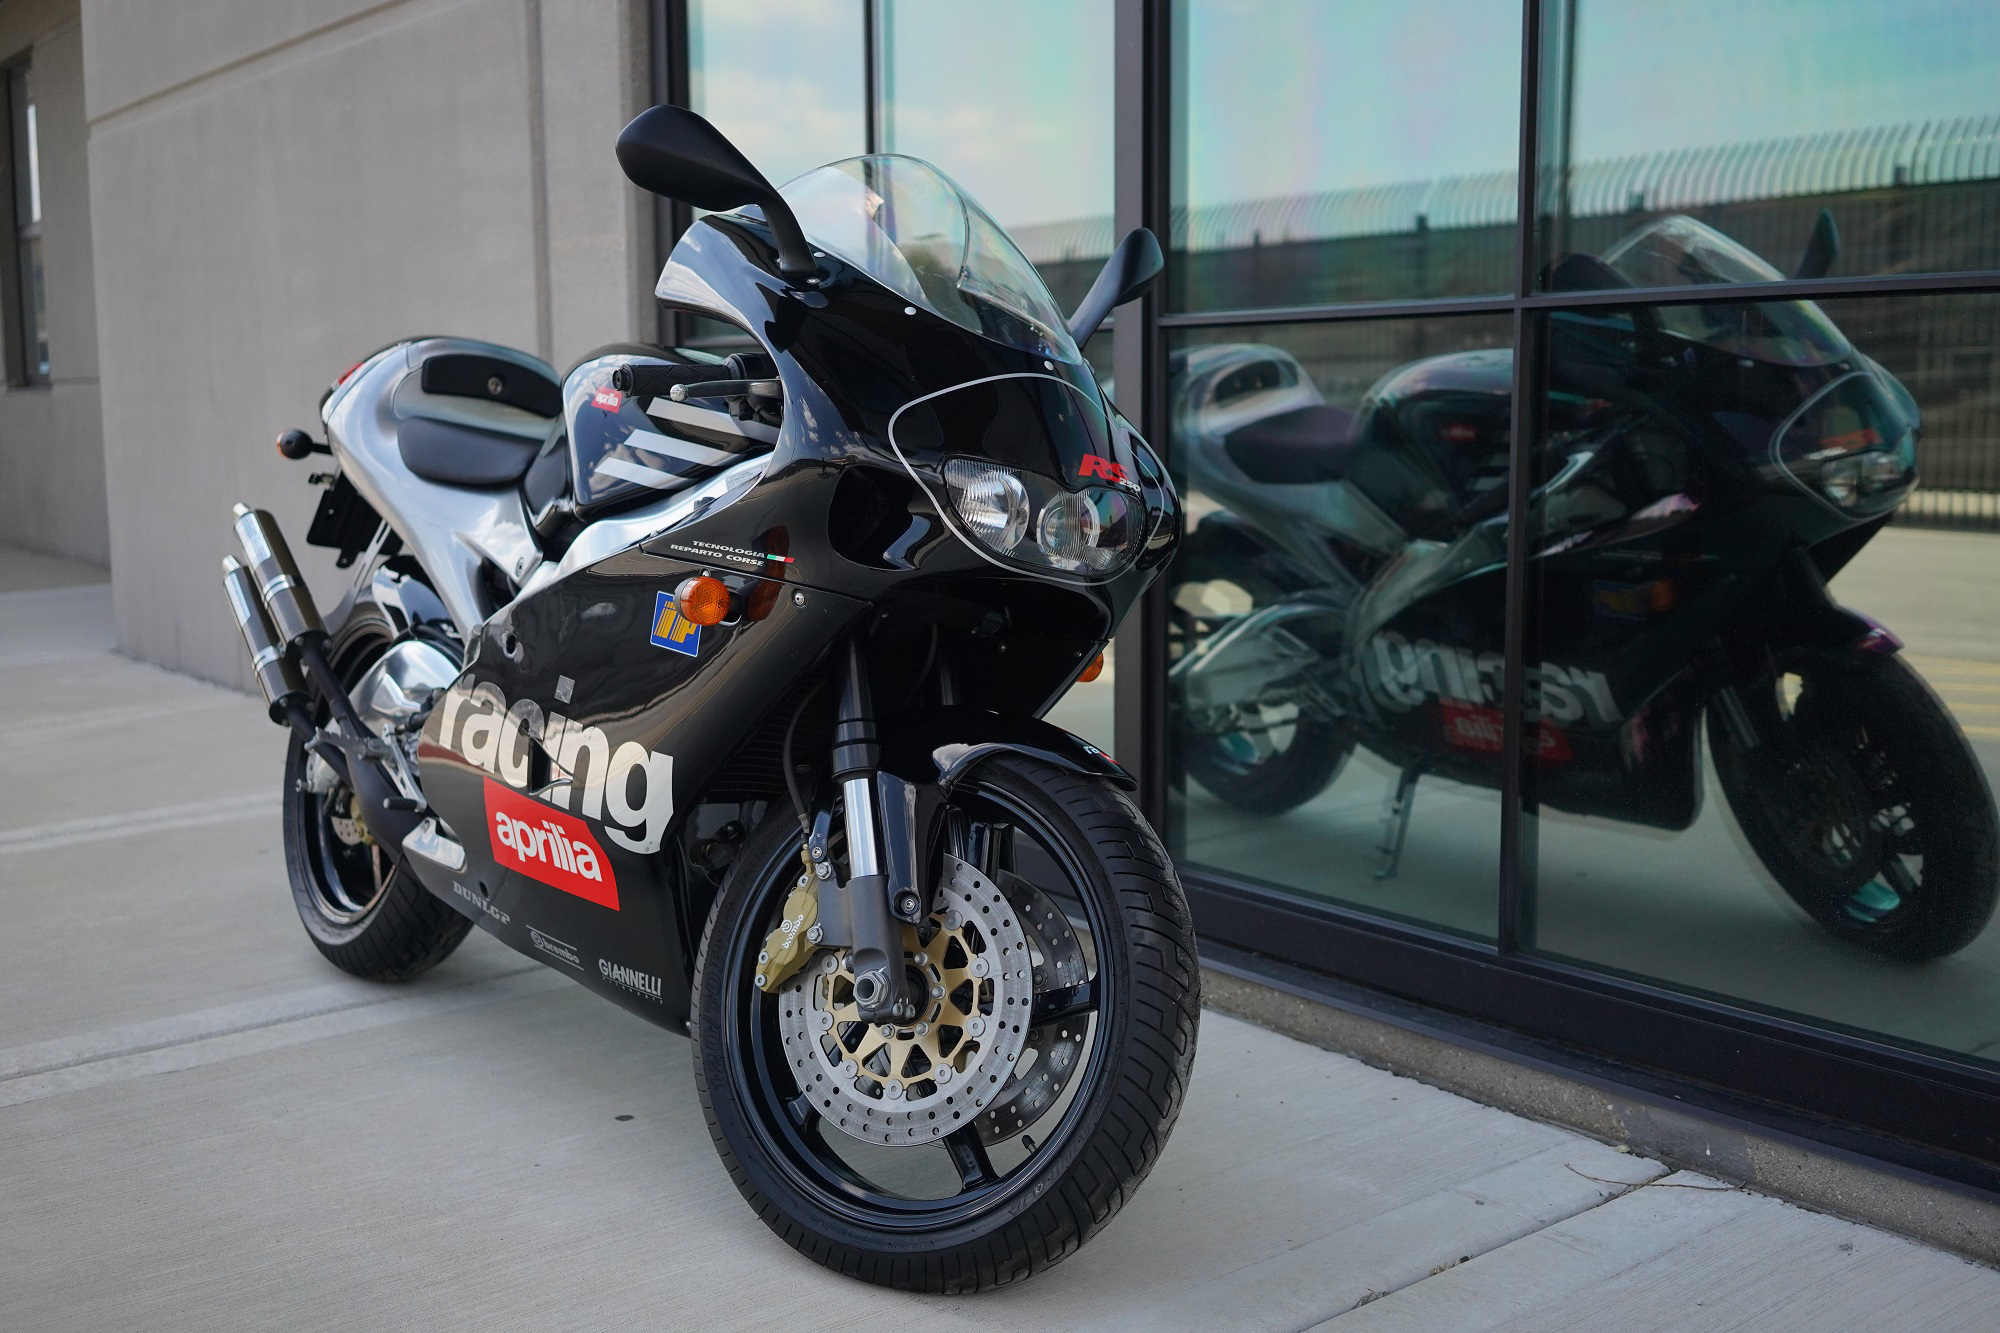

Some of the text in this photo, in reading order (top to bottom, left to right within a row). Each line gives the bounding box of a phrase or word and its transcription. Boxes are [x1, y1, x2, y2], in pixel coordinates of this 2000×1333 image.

[595, 392, 619, 407] aprilia
[1078, 453, 1129, 484] RS
[670, 544, 765, 567] REPARTO CORSE
[692, 540, 766, 559] TECNOLOGIA
[438, 673, 674, 855] racing
[495, 811, 603, 882] aprilia
[452, 880, 511, 925] DUNLOP
[782, 914, 804, 949] brembo
[541, 937, 580, 964] brembo
[598, 958, 662, 997] GIANNELLI
